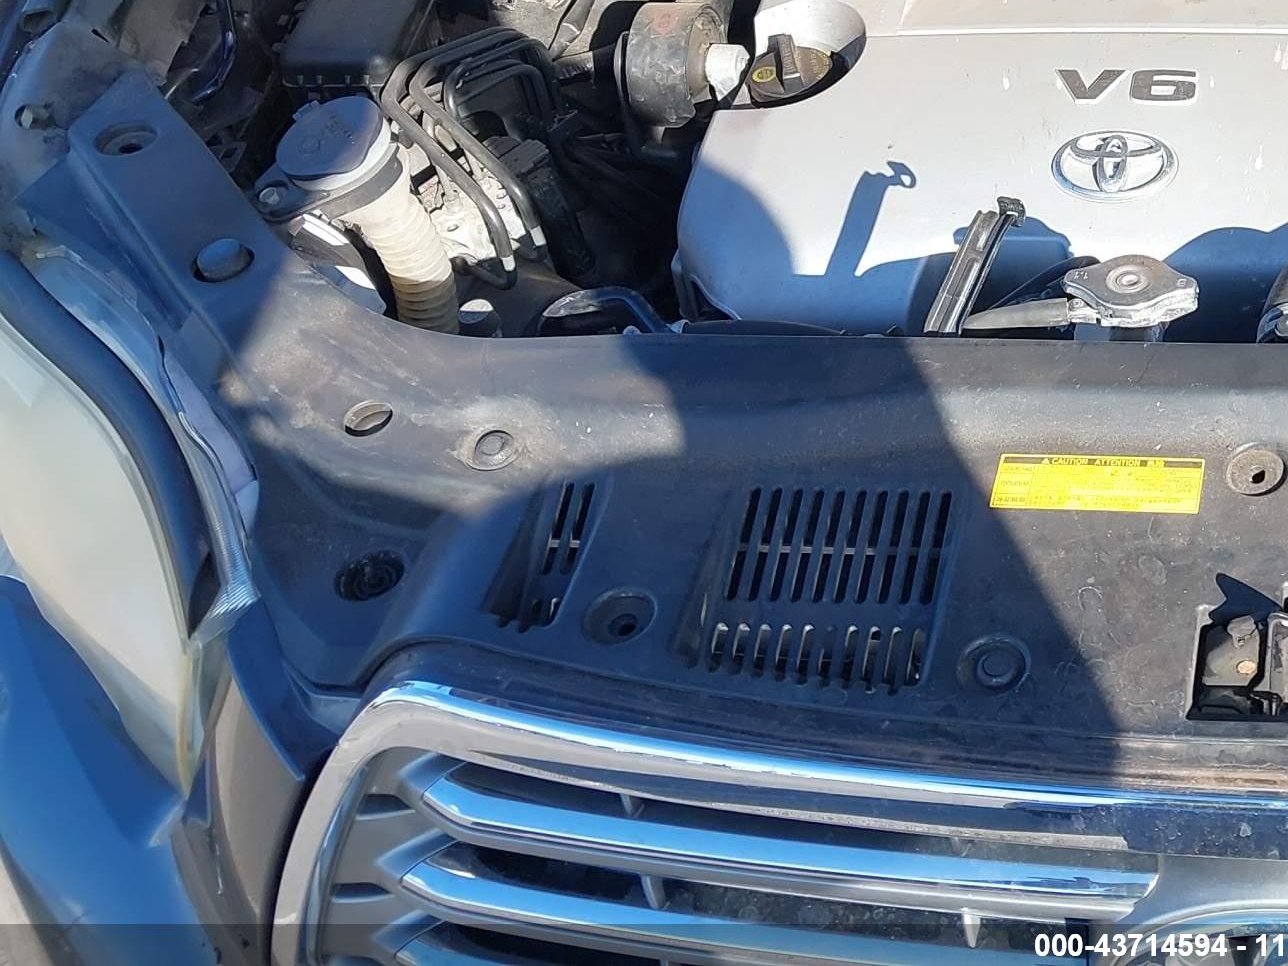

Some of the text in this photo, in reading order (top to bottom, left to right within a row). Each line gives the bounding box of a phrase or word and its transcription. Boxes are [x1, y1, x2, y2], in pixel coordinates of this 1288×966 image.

[1056, 69, 1197, 103] V6
[1051, 457, 1089, 466] CAUTION
[1093, 458, 1141, 467] ATTENTION
